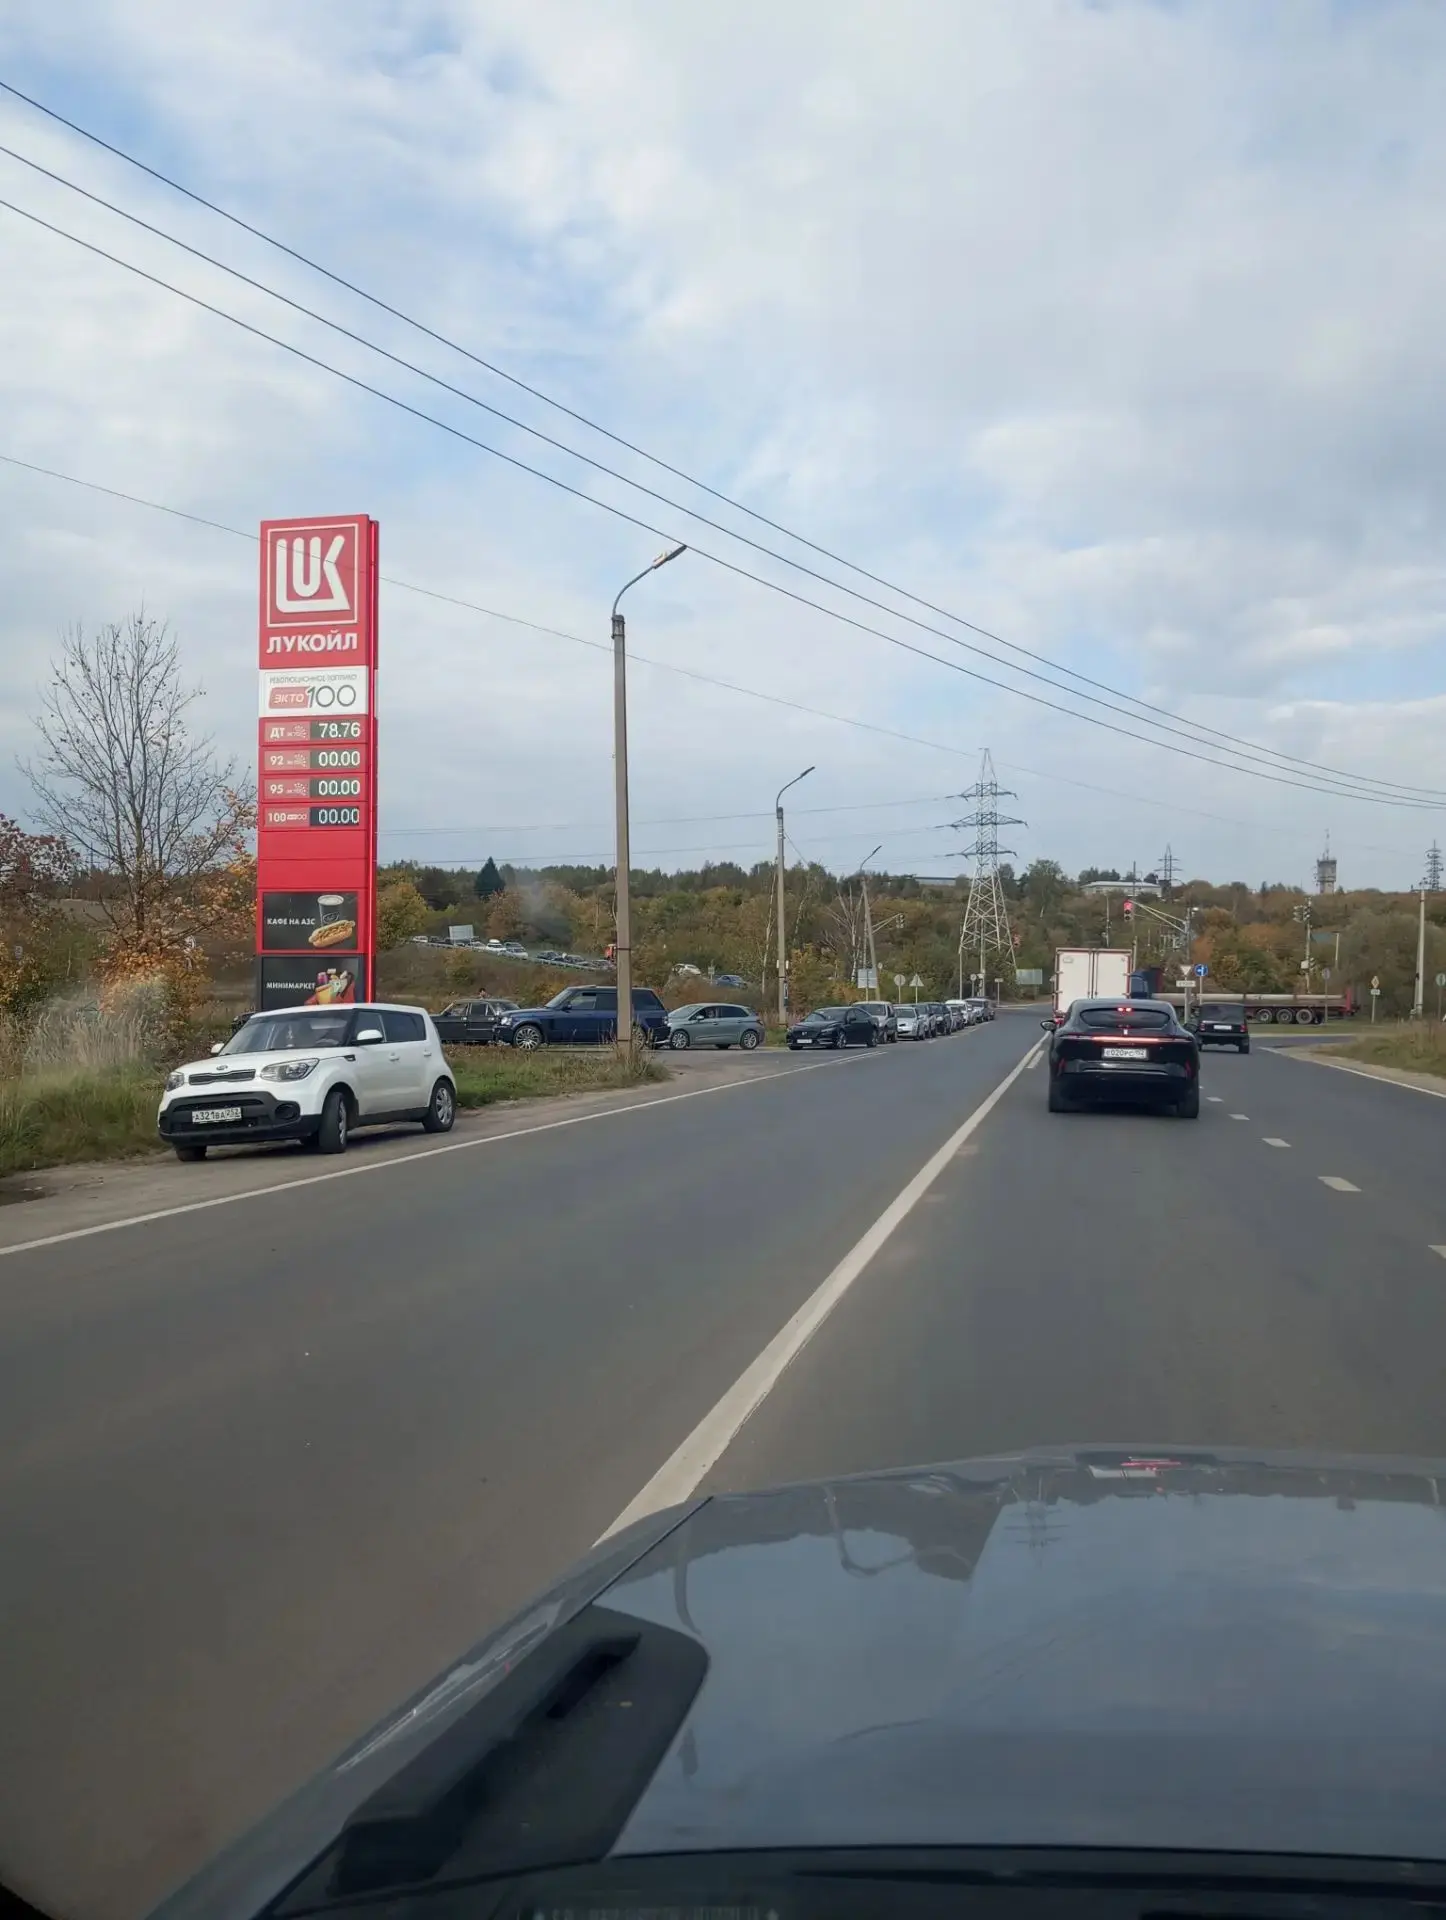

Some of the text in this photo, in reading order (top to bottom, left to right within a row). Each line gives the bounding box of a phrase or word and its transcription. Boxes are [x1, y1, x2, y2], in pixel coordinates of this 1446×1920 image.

[266, 629, 358, 654] ЛУКОЙЛ
[273, 685, 357, 708] ЭКТО 100
[270, 727, 285, 739] ДТ
[318, 722, 361, 738] 78.76
[270, 756, 284, 766] 92
[318, 751, 361, 767] 00.00
[270, 784, 284, 794] 95
[318, 780, 361, 796] 00.00
[268, 812, 287, 822] 100
[318, 809, 360, 824] 00.00
